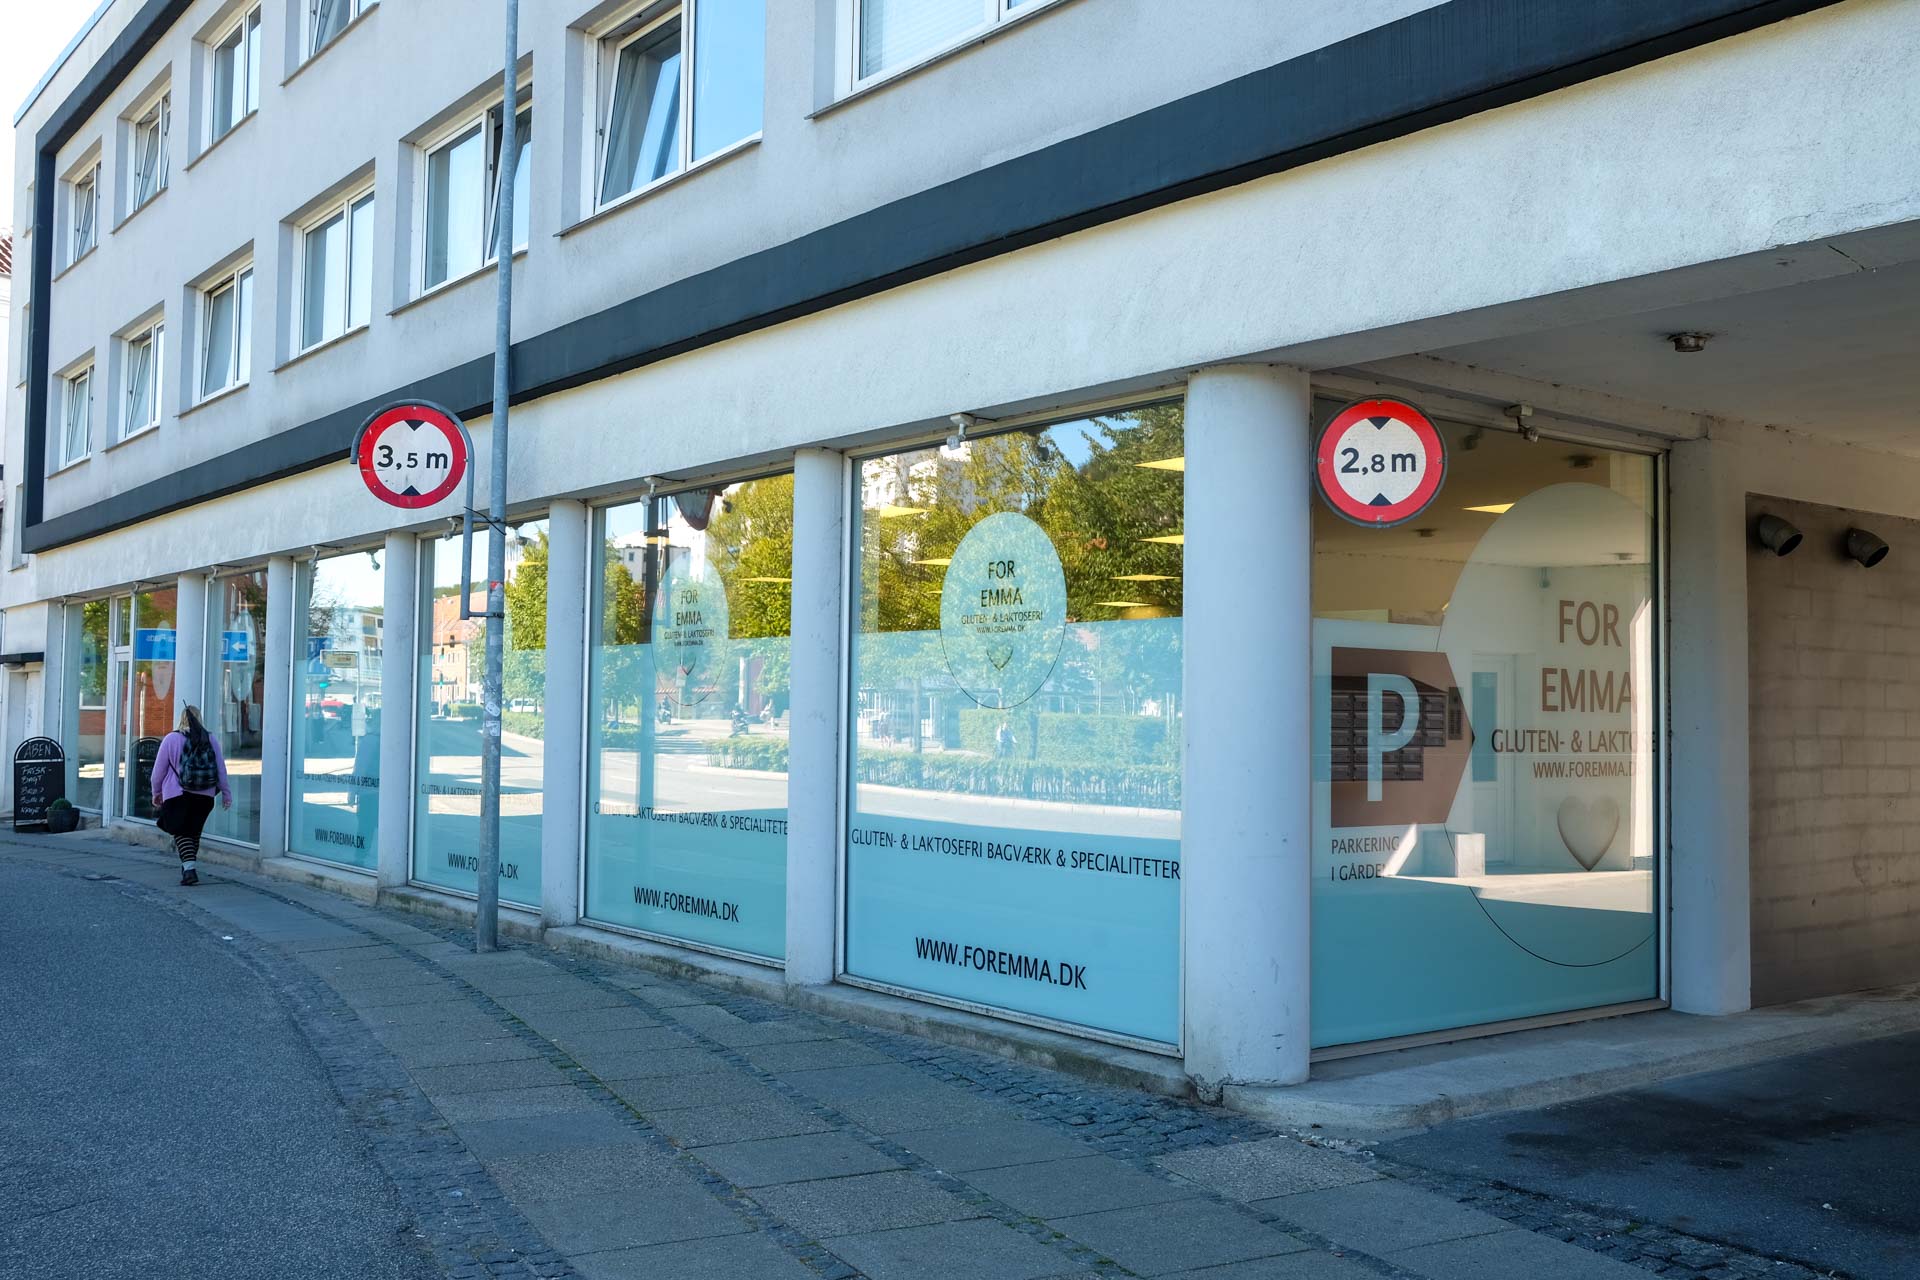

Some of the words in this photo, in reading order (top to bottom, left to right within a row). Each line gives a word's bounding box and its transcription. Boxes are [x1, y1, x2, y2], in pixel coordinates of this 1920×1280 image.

[377, 445, 418, 470] 3,5
[426, 452, 448, 469] m
[1341, 447, 1385, 475] 2,8
[1391, 453, 1417, 472] m
[988, 560, 1015, 579] FOR
[681, 590, 698, 604] FOR
[981, 588, 1023, 607] EMMA
[676, 611, 702, 626] EMMA
[1559, 600, 1622, 647] FOR
[1542, 667, 1638, 713] EMMA
[1367, 672, 1420, 801] P
[1491, 729, 1565, 753] GLUTEN-
[1571, 730, 1583, 752] &
[1533, 761, 1641, 778] WWW.FOREMMA.D
[720, 815, 727, 828] &
[315, 828, 365, 849] WWW.FOREMMA.DK
[1331, 836, 1400, 854] PARKERING
[851, 828, 897, 847] GLUTEN-
[900, 833, 909, 849] &
[912, 834, 983, 858] LAKTOSEFRI
[987, 843, 1051, 865] BAGVÆRK
[1056, 849, 1066, 867] &
[1070, 851, 1181, 880] SPECIALITETER
[1331, 866, 1335, 881] I
[634, 886, 739, 922] WWW.FOREMMA.DK
[916, 937, 1087, 990] WWW.FOREMMA.DK
